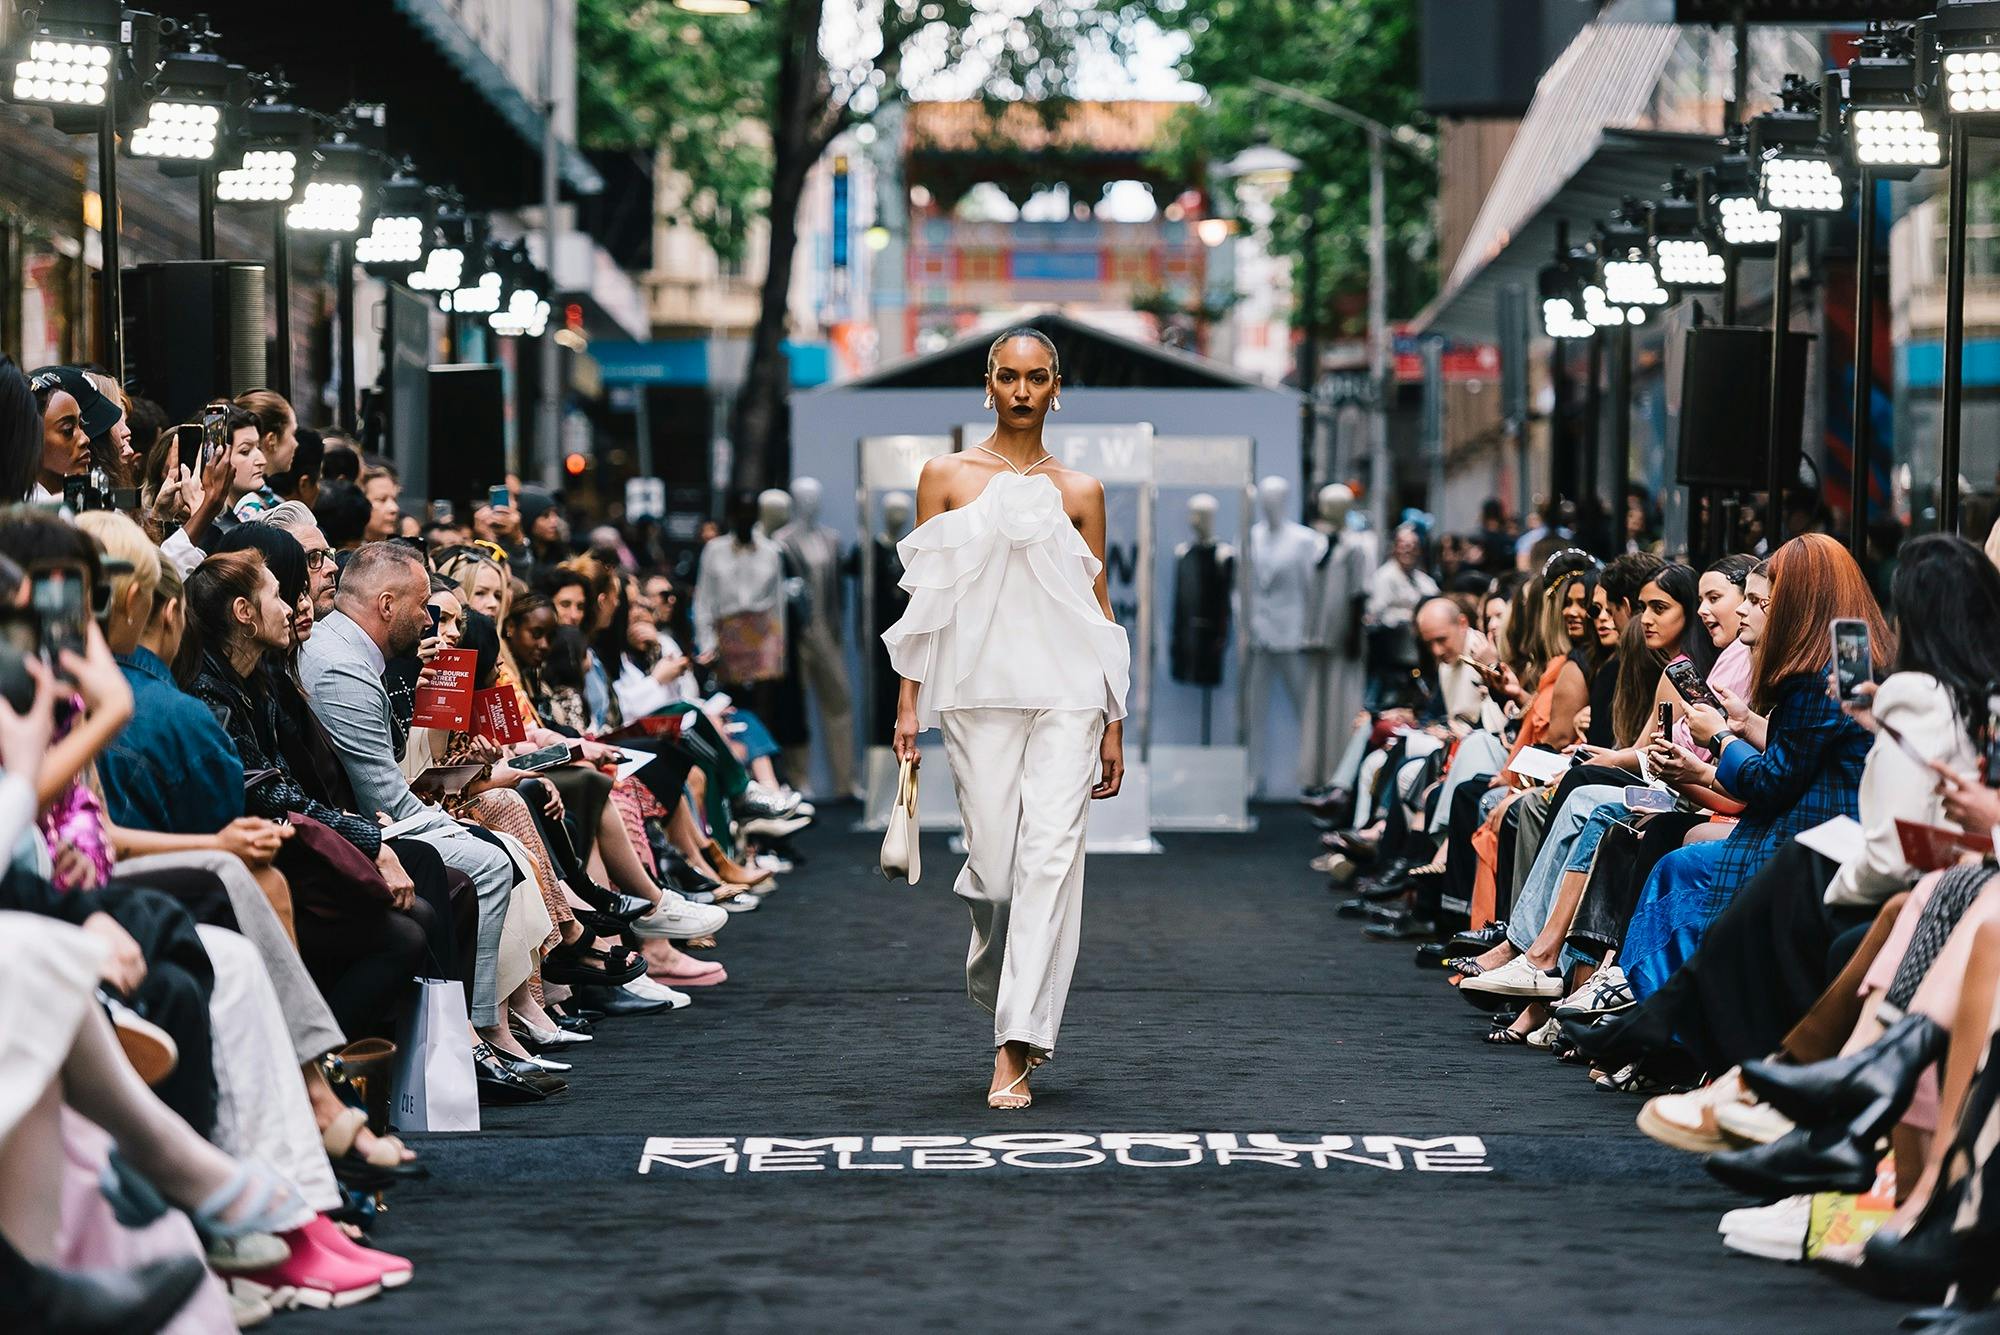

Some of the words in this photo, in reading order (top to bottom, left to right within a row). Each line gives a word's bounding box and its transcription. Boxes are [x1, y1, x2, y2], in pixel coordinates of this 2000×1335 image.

[442, 670, 469, 678] BOURKE
[642, 1133, 1487, 1156] EMPORIUM
[638, 1147, 1493, 1174] MELBOURNE
